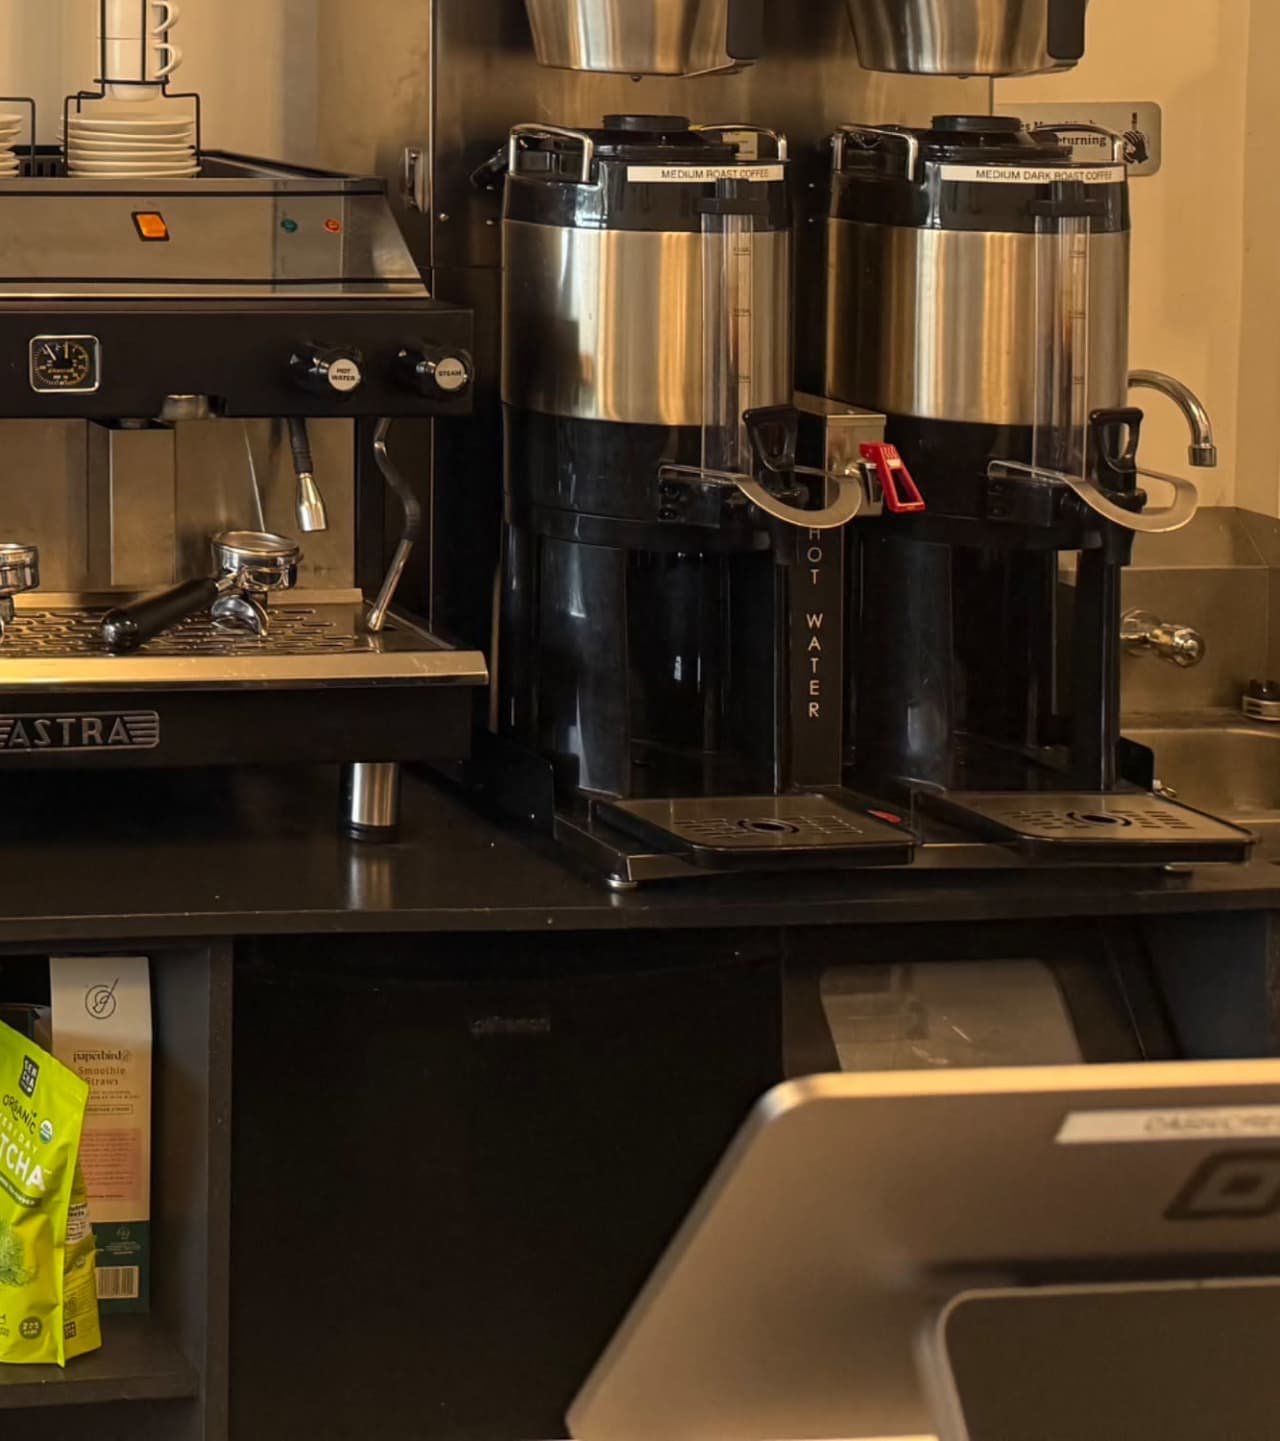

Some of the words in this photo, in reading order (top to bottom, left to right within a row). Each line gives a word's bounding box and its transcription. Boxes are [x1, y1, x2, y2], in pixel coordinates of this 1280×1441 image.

[661, 169, 702, 180] MEDIUM
[706, 169, 737, 180] ROAST
[739, 169, 770, 179] COFFEE
[976, 169, 1020, 181] MEDIUM
[1022, 171, 1051, 181] DARK
[1054, 171, 1084, 182] ROAST
[1085, 170, 1113, 181] COFFEE
[331, 374, 356, 382] WATER
[806, 613, 824, 718] WATER
[7, 717, 131, 748] ASTRA
[79, 1066, 126, 1076] Smoothie
